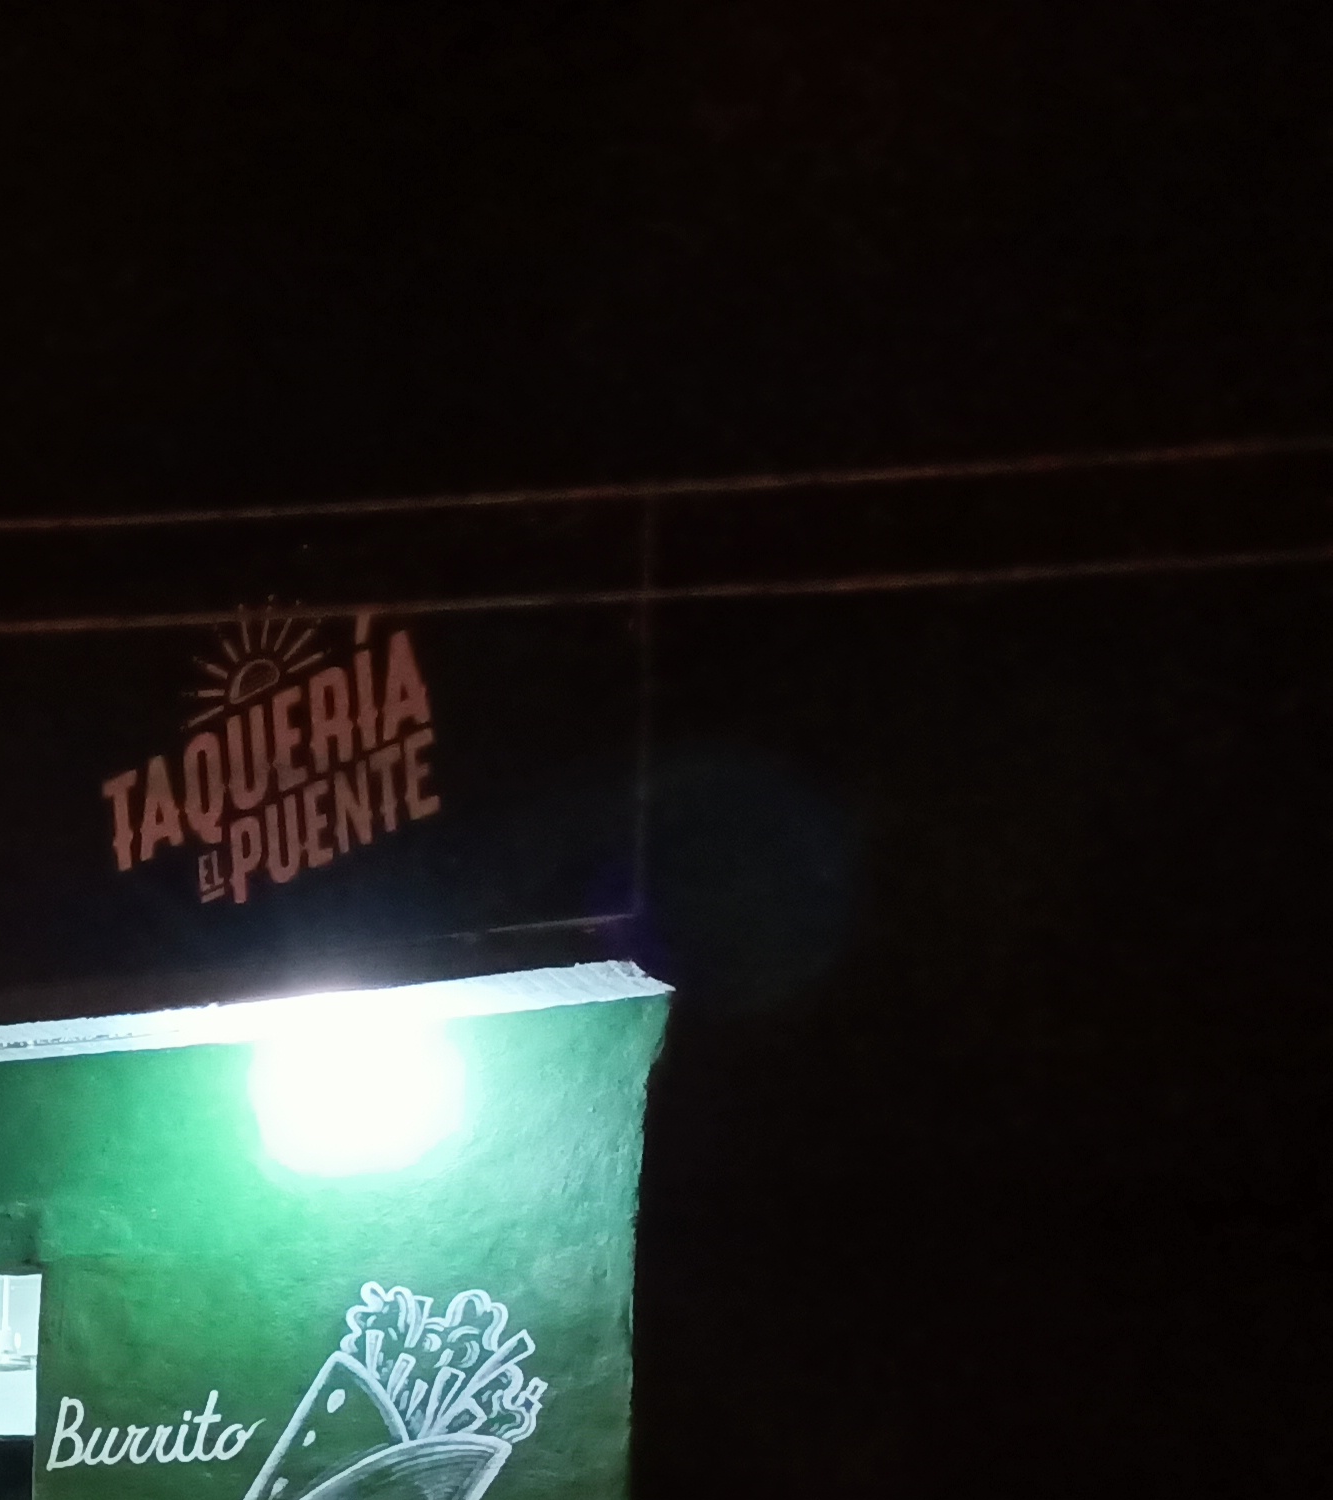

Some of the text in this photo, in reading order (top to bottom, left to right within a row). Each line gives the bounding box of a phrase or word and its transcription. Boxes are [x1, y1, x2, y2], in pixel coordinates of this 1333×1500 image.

[102, 608, 431, 872] TAQUERÍA
[198, 728, 440, 904] EL PUENTE
[46, 1389, 267, 1471] Burrito
